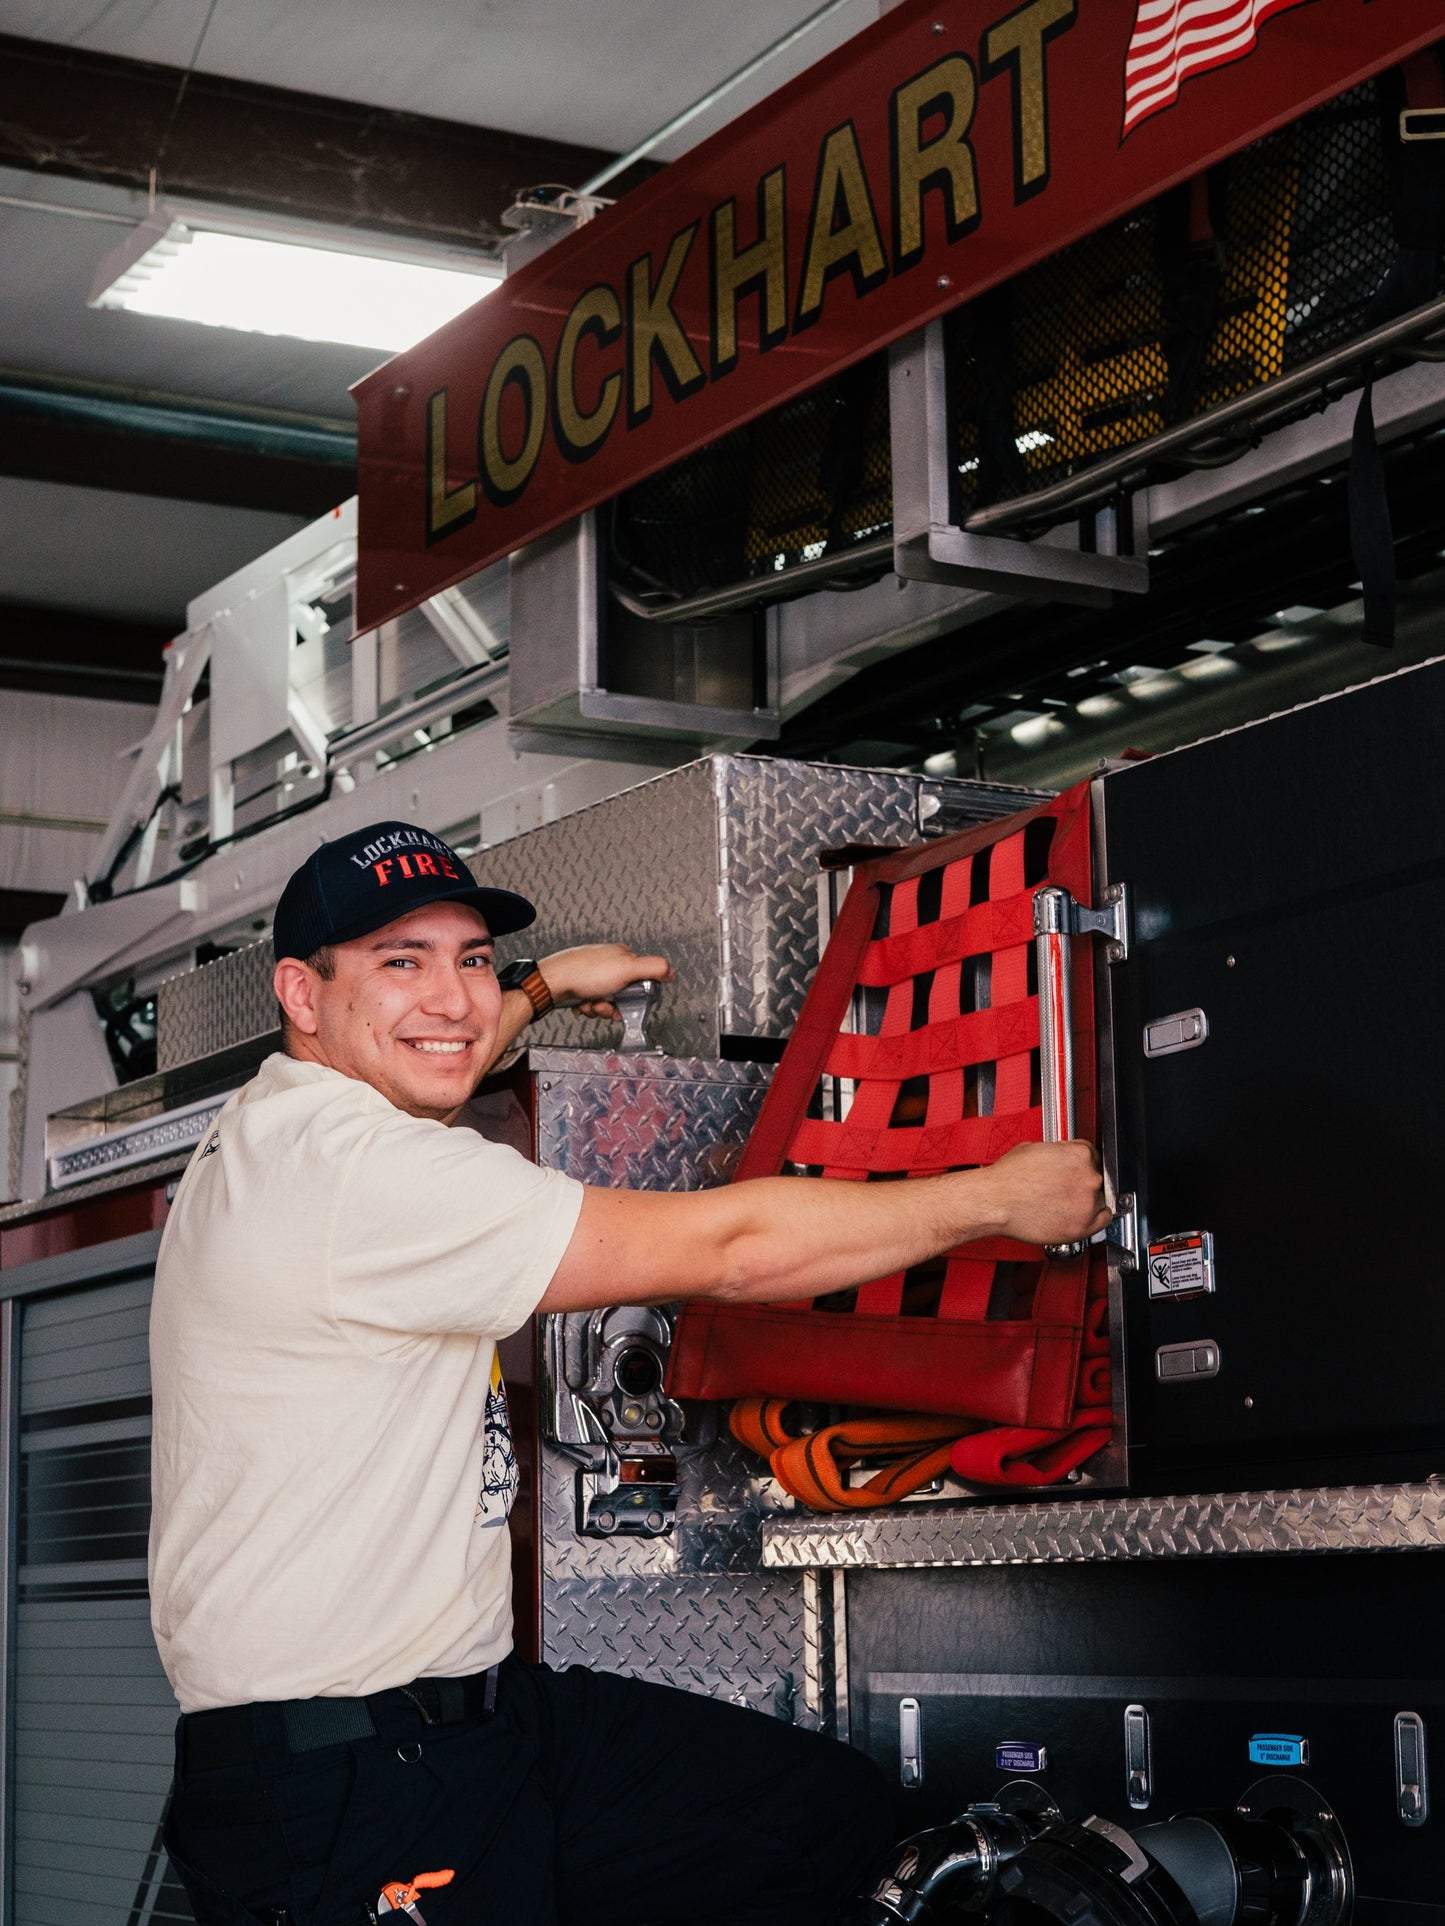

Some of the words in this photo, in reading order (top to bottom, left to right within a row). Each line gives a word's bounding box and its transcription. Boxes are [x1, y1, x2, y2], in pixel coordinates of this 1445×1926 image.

[425, 0, 1077, 547] LOCKHART
[350, 830, 455, 870] LOCKHART
[372, 853, 460, 887] FIRE
[1256, 1743, 1282, 1751] PASSENGER
[1001, 1750, 1023, 1758] PASSENGER
[1266, 1753, 1291, 1761] DISCHARGE
[1013, 1759, 1035, 1767] DISCHARGE
